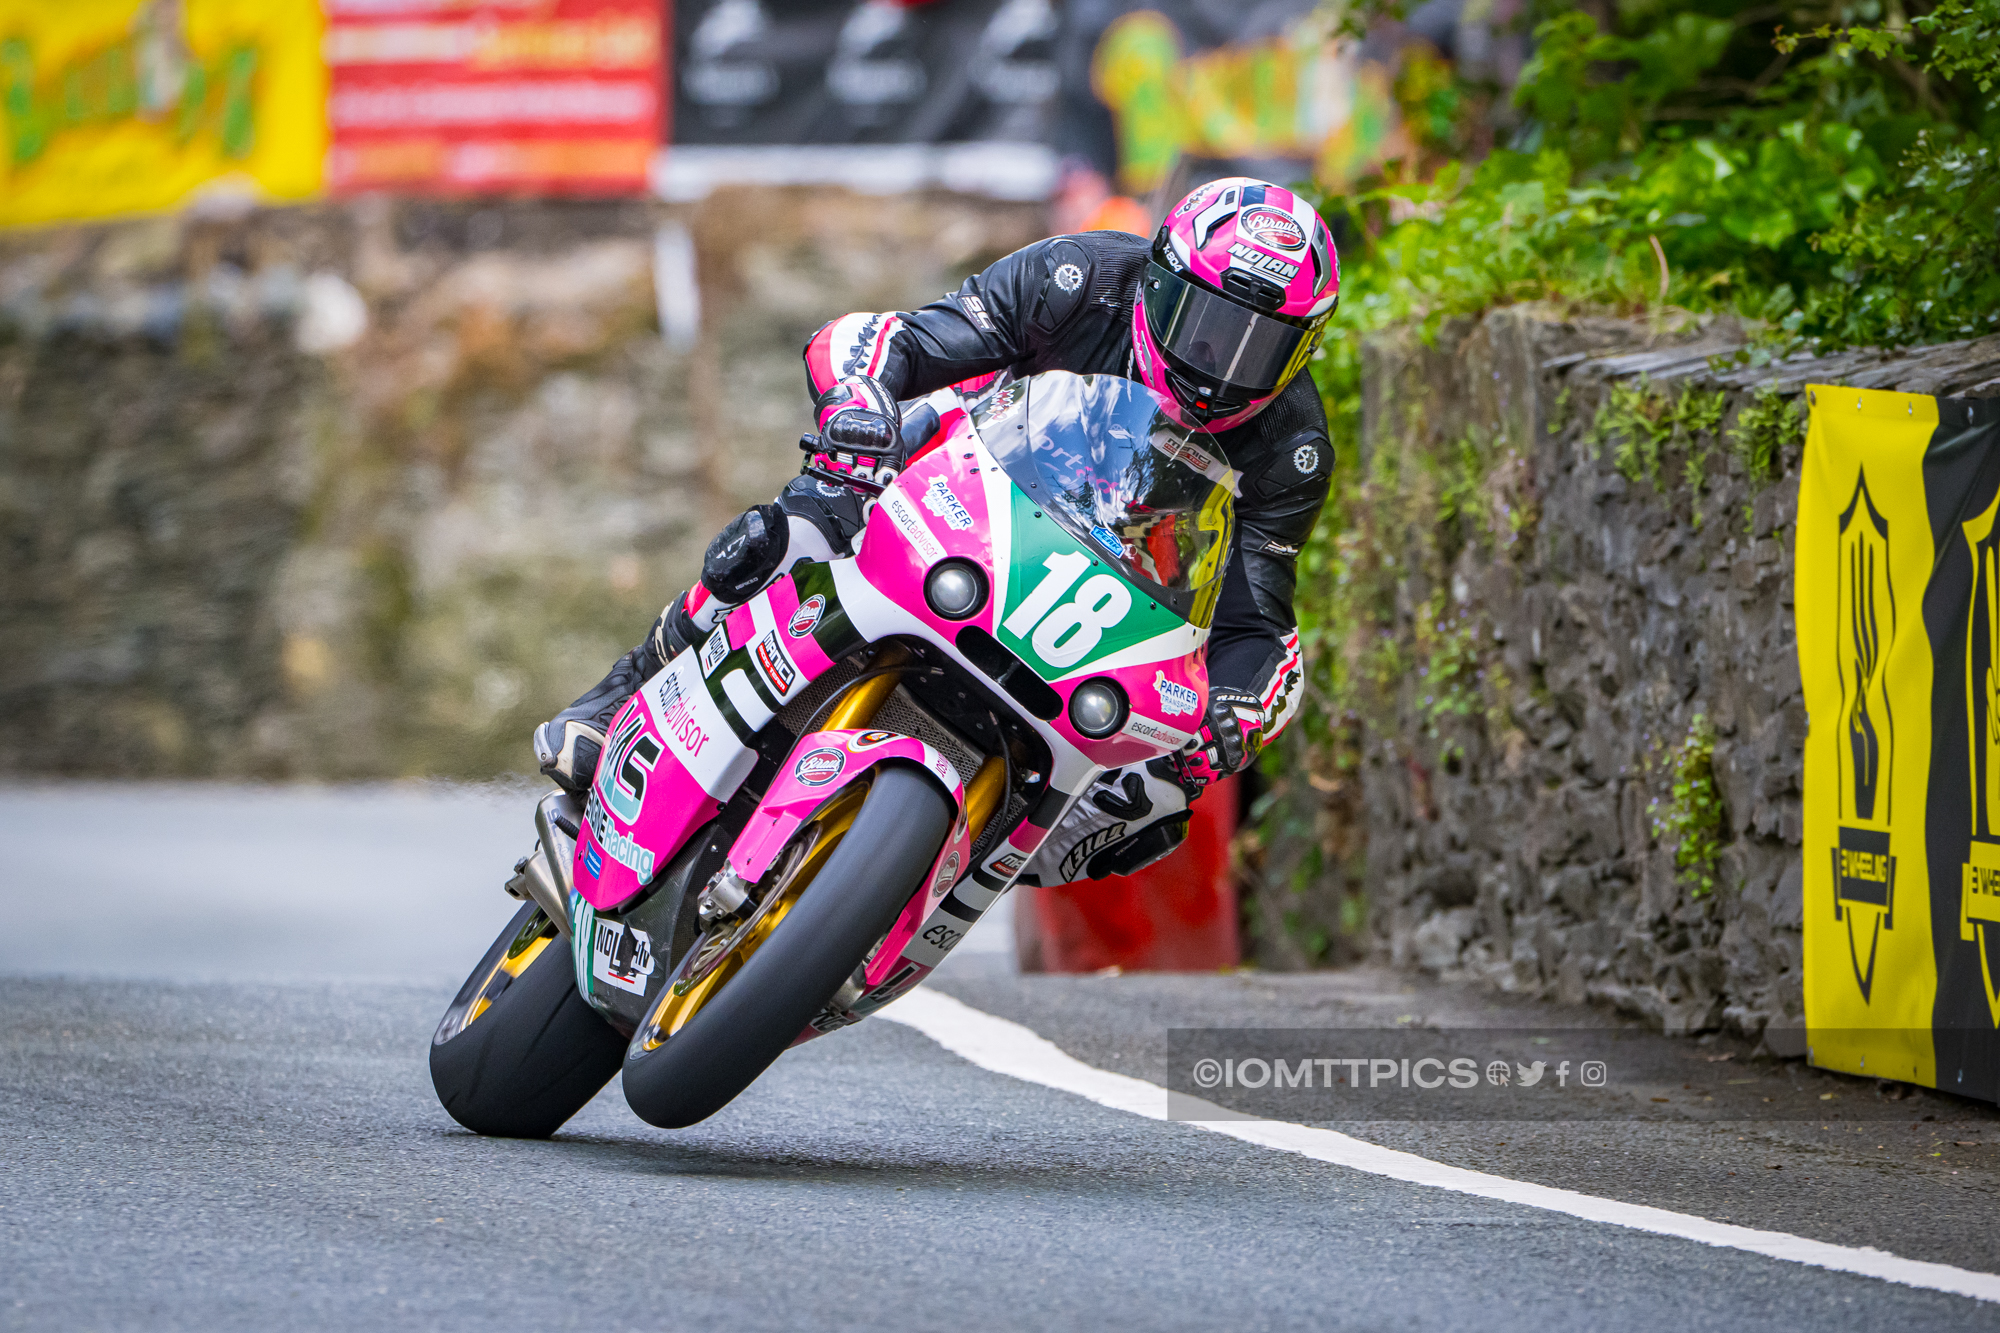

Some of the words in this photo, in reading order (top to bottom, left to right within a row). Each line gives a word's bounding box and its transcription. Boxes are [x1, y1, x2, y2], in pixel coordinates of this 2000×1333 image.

[1228, 242, 1300, 282] NOLAN
[933, 481, 972, 527] PARKER
[891, 500, 938, 558] escortadvisor
[1002, 550, 1132, 668] 18
[1159, 680, 1197, 706] PARKER
[1131, 722, 1182, 745] escortadvisor
[603, 820, 655, 884] Racing
